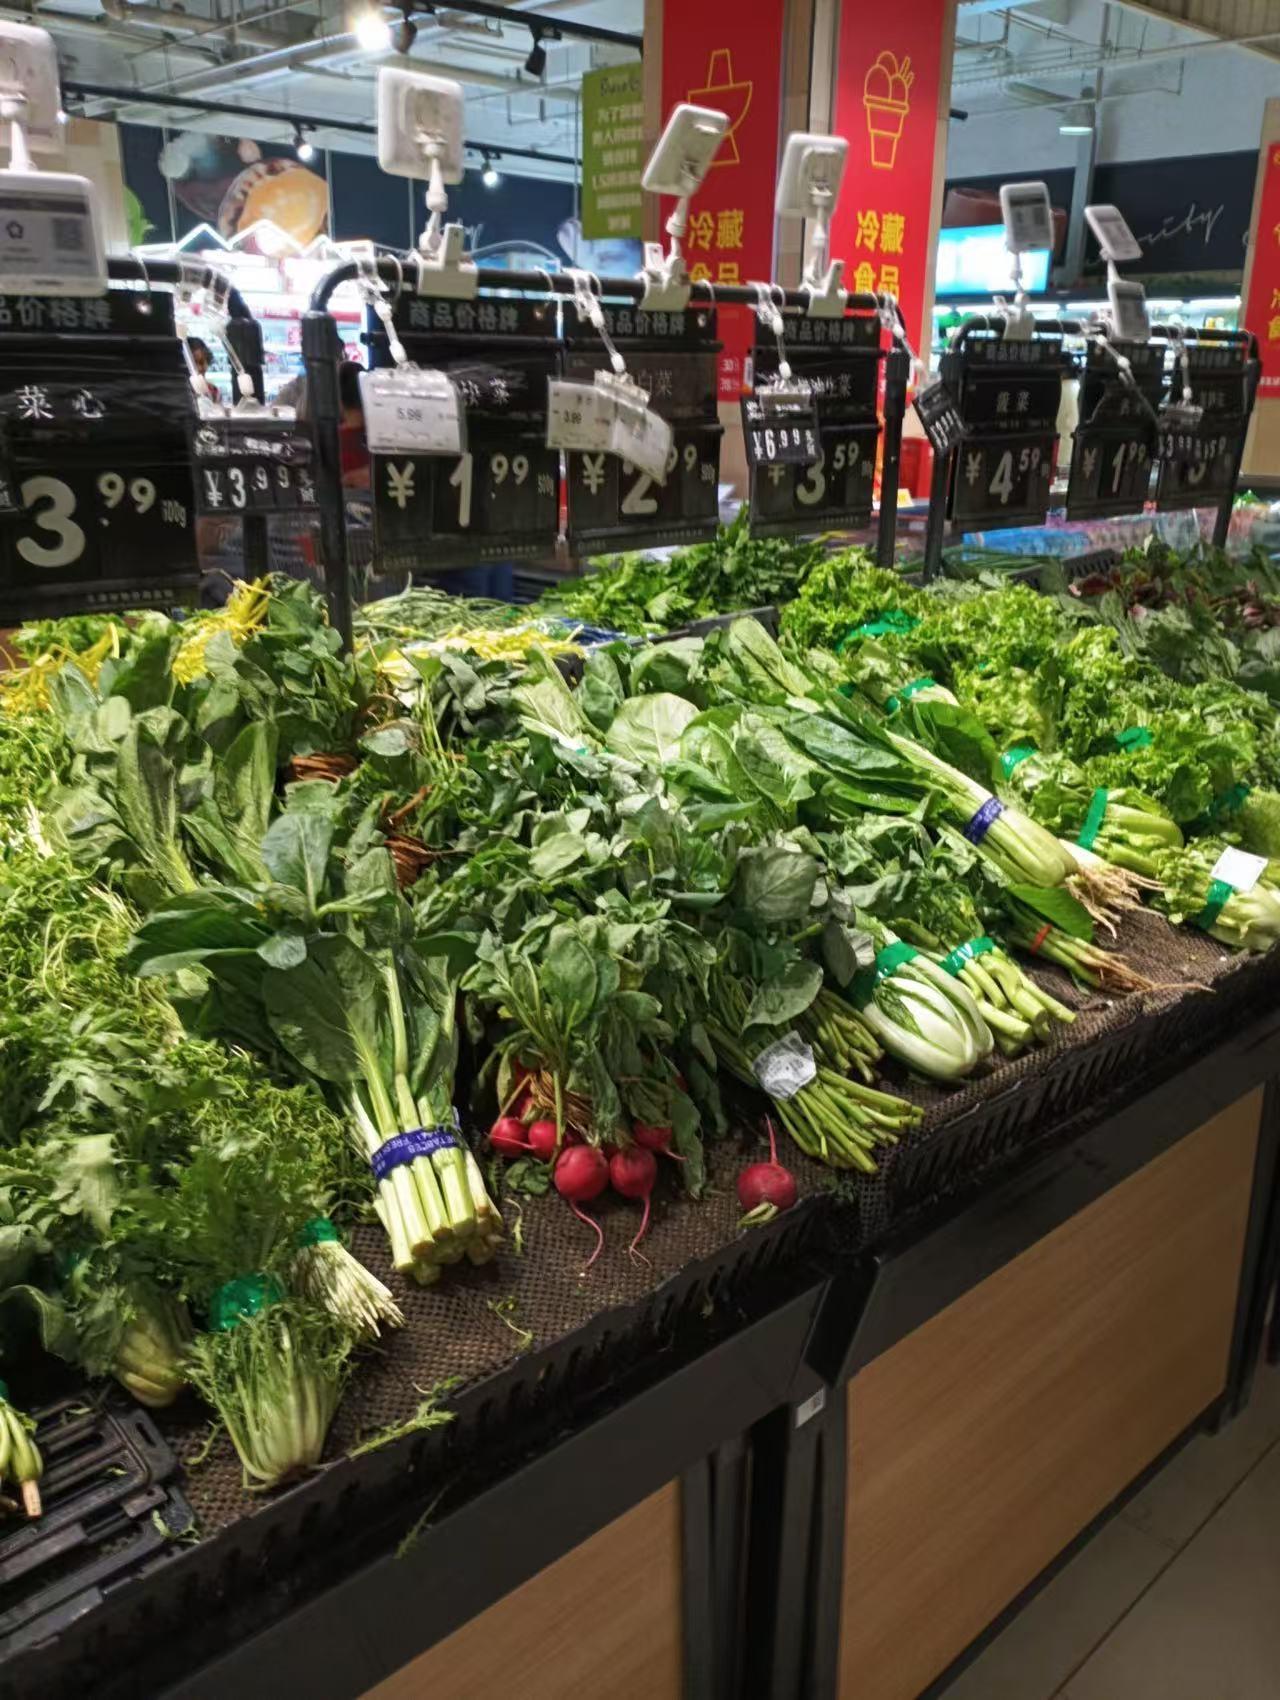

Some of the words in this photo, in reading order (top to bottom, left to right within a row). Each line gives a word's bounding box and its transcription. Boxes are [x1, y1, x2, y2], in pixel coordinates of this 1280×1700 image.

[688, 210, 744, 250] 冷藏
[855, 210, 905, 253] 冷藏
[409, 302, 519, 332] 商品价格牌
[15, 385, 107, 420] 菜心
[449, 451, 529, 528] 1.99
[988, 448, 1041, 504] 4.59
[16, 471, 157, 568] 3.99
